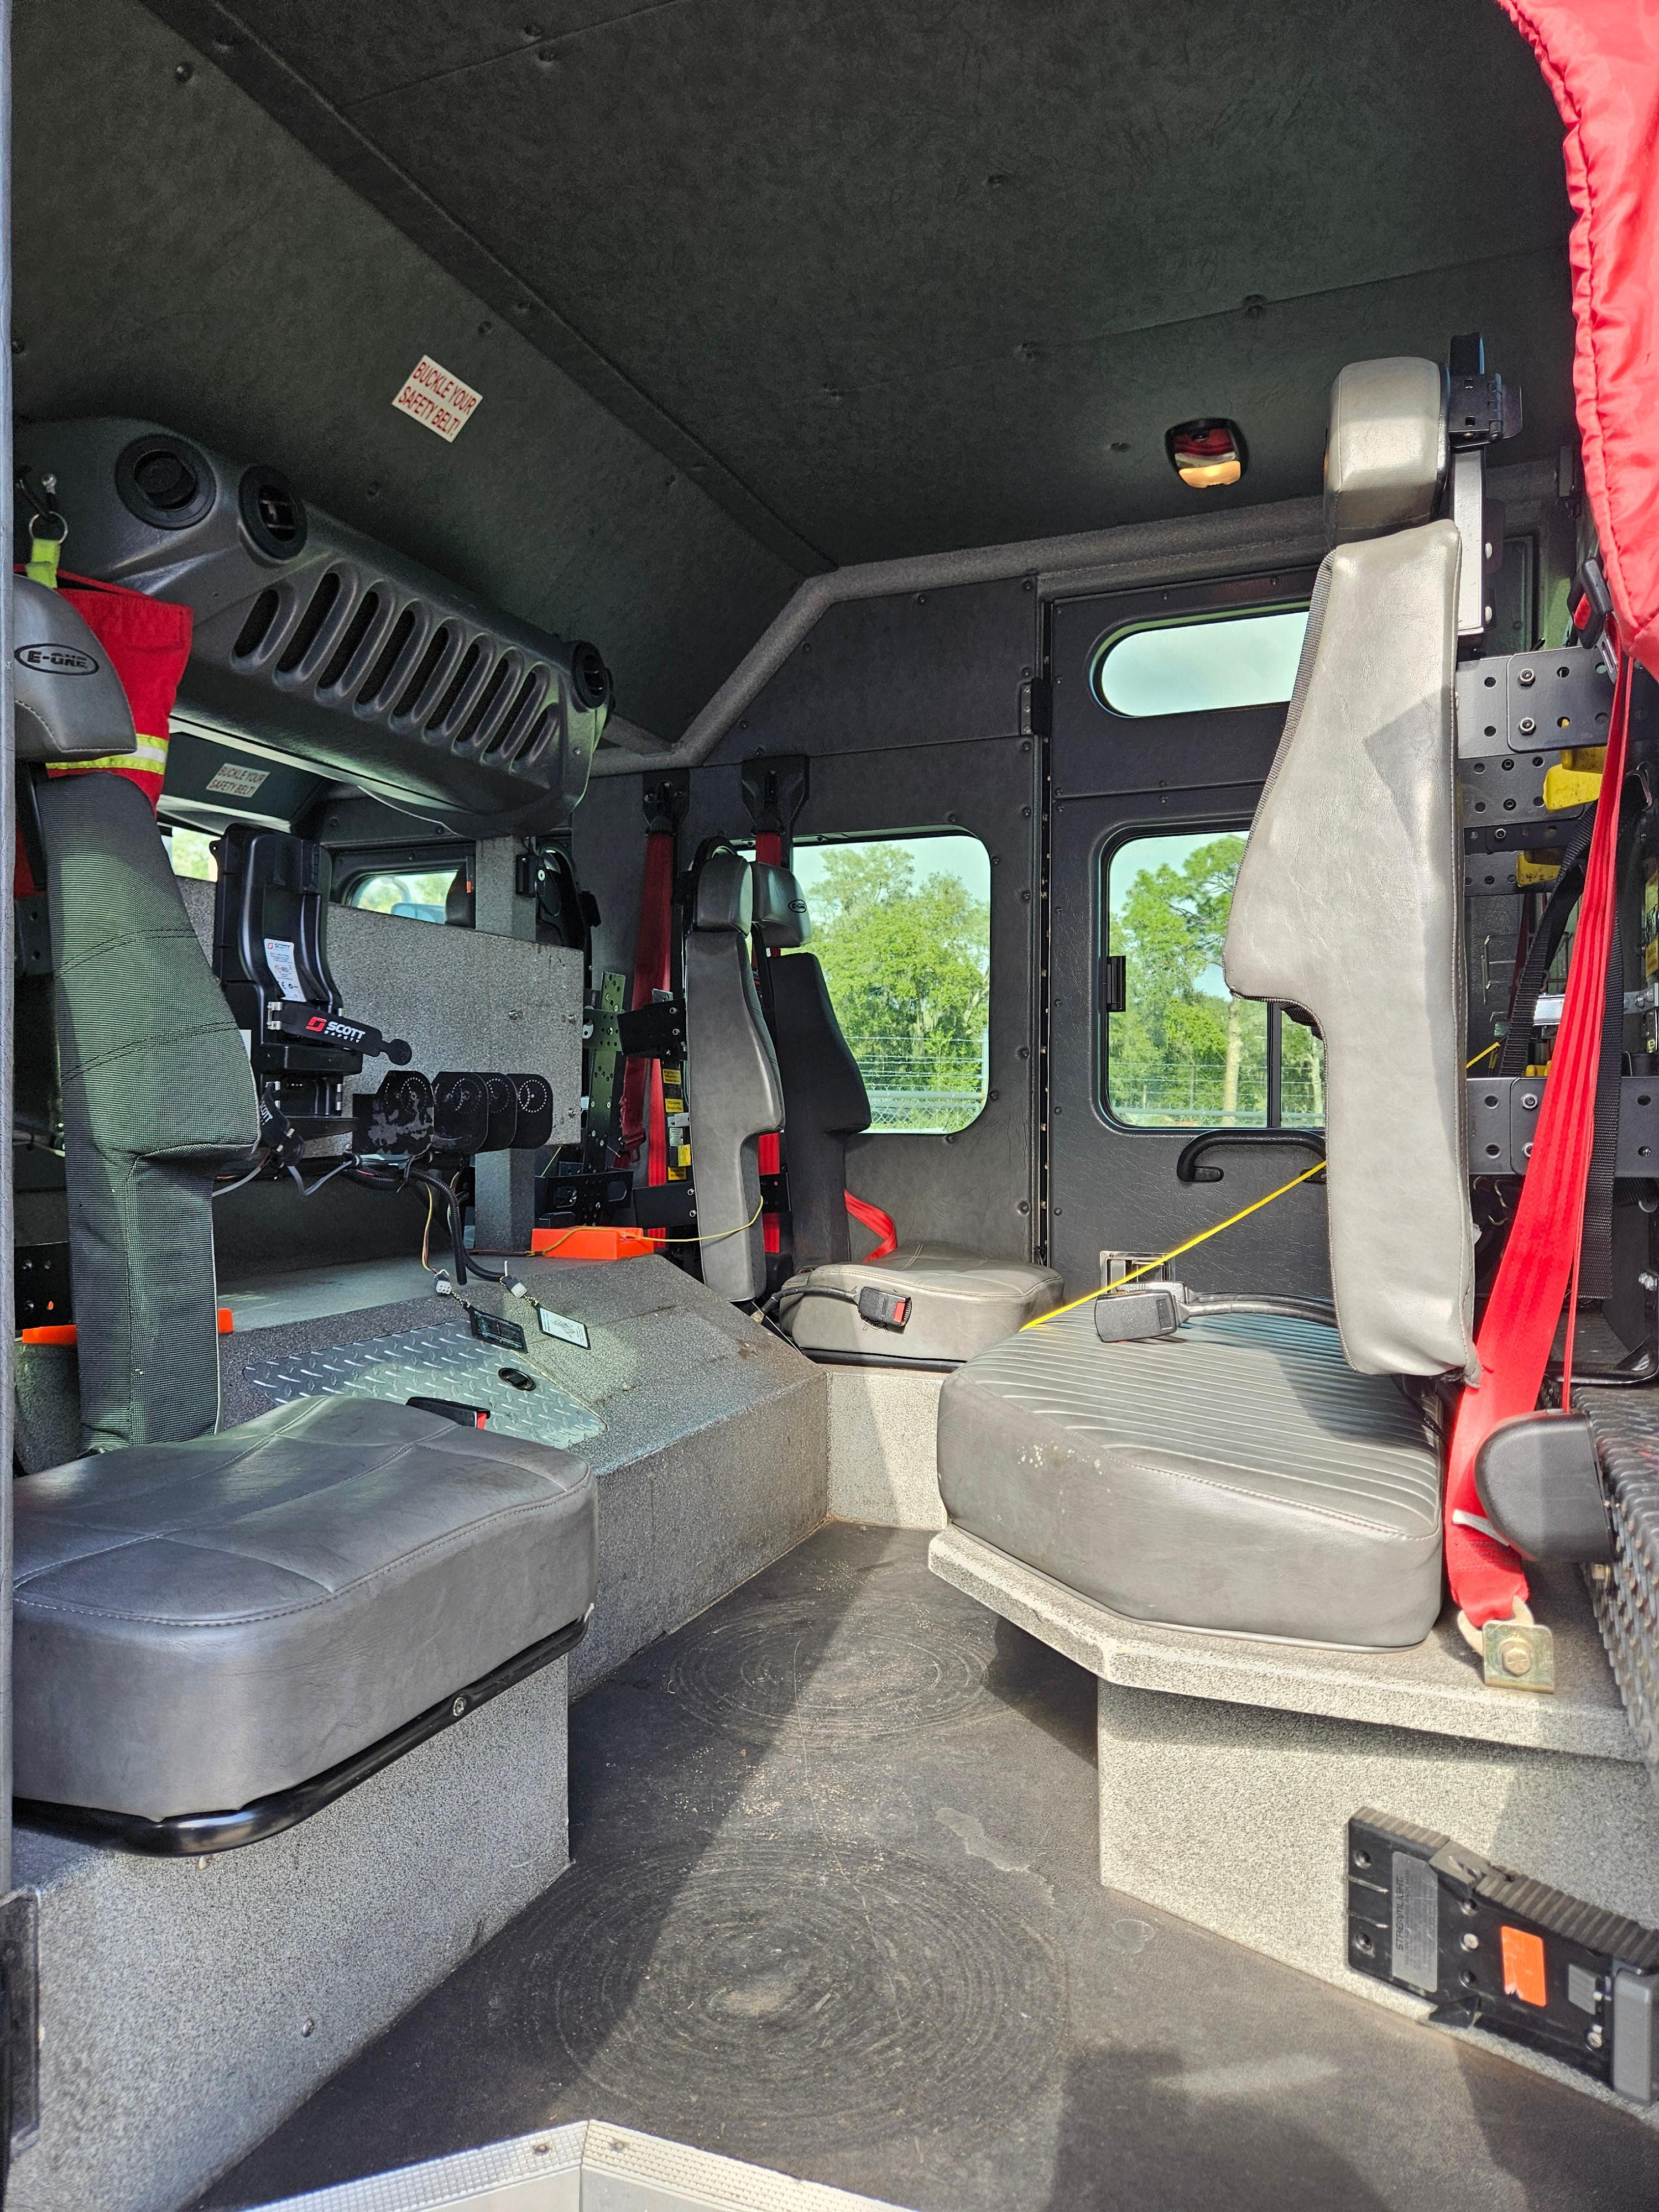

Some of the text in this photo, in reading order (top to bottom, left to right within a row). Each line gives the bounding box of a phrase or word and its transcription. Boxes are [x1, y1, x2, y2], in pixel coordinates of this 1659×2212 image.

[413, 361, 477, 415] BUCKLE YOUR
[398, 386, 461, 436] SAFETY BELT!
[28, 650, 88, 669] E-ONE
[218, 766, 266, 784] BUCKLE YOUR
[209, 779, 237, 792] SAFETY
[326, 1021, 366, 1040] SCOTT
